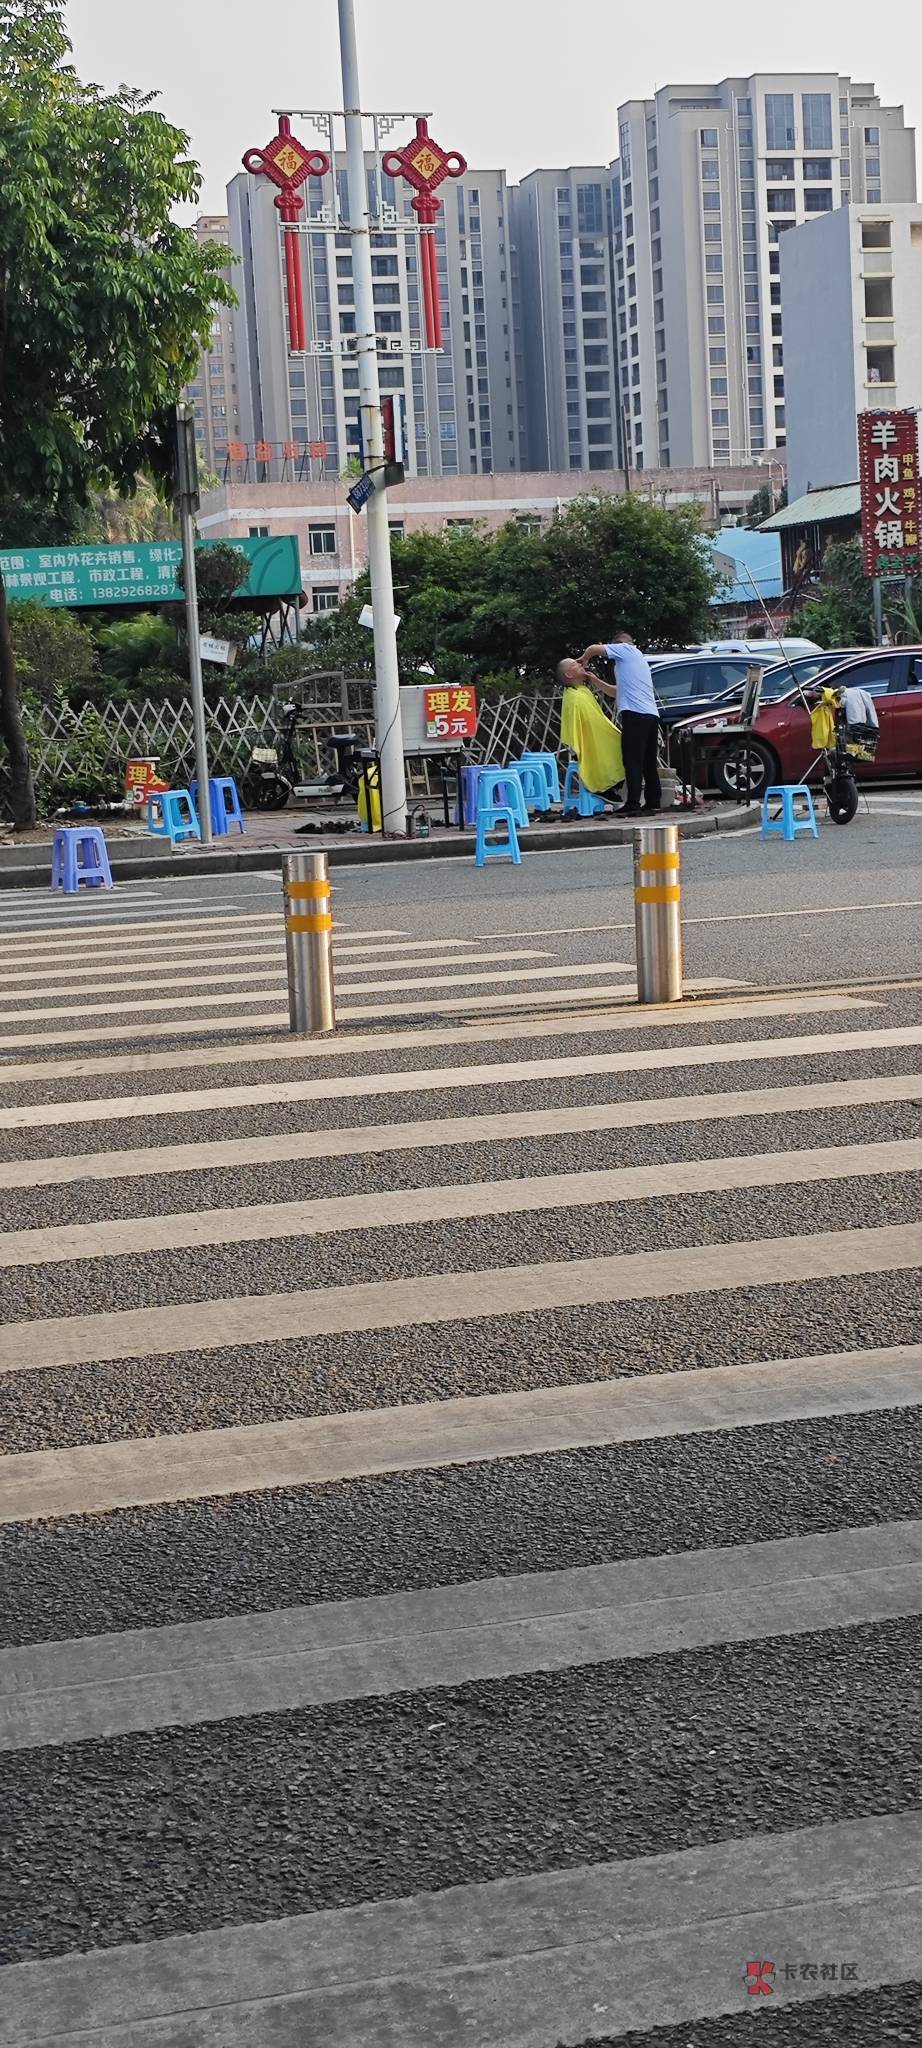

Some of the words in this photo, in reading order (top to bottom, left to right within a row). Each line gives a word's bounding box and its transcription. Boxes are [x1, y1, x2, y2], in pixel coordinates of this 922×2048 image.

[278, 151, 298, 171] 福
[416, 153, 436, 173] 福
[871, 420, 904, 549] 羊肉火锅
[427, 690, 473, 713] 理发
[434, 714, 468, 736] 5元
